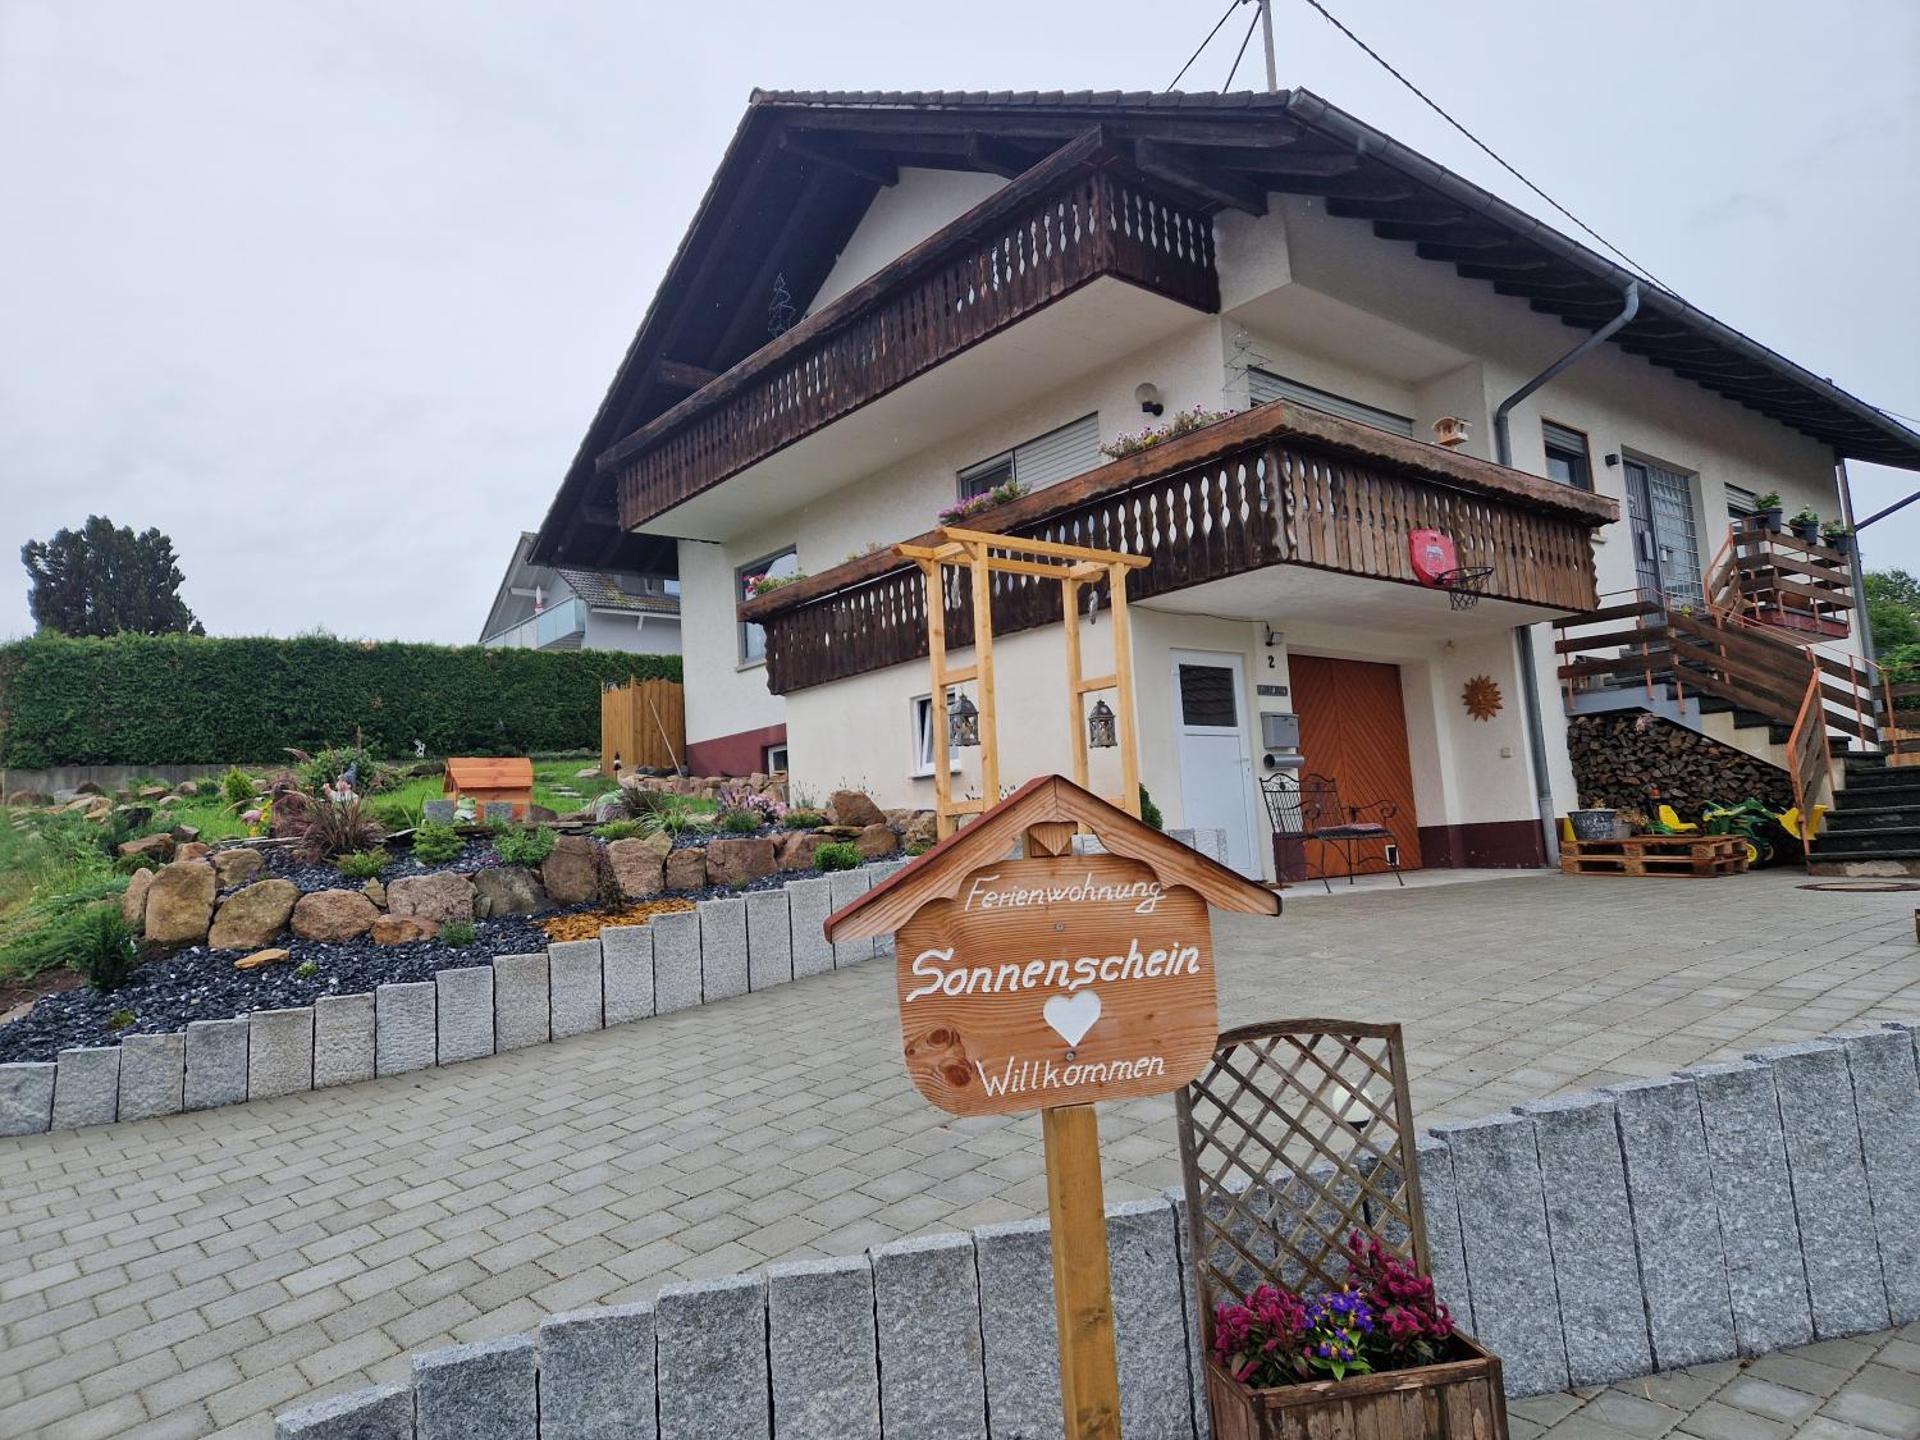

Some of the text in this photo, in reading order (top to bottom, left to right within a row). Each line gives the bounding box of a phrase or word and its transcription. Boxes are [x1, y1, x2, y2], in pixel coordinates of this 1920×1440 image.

[1267, 655, 1275, 669] 2
[964, 873, 1166, 913] Ferienwohnung
[906, 938, 1200, 1002] Sonnenschein
[975, 1056, 1165, 1097] Willkommen
